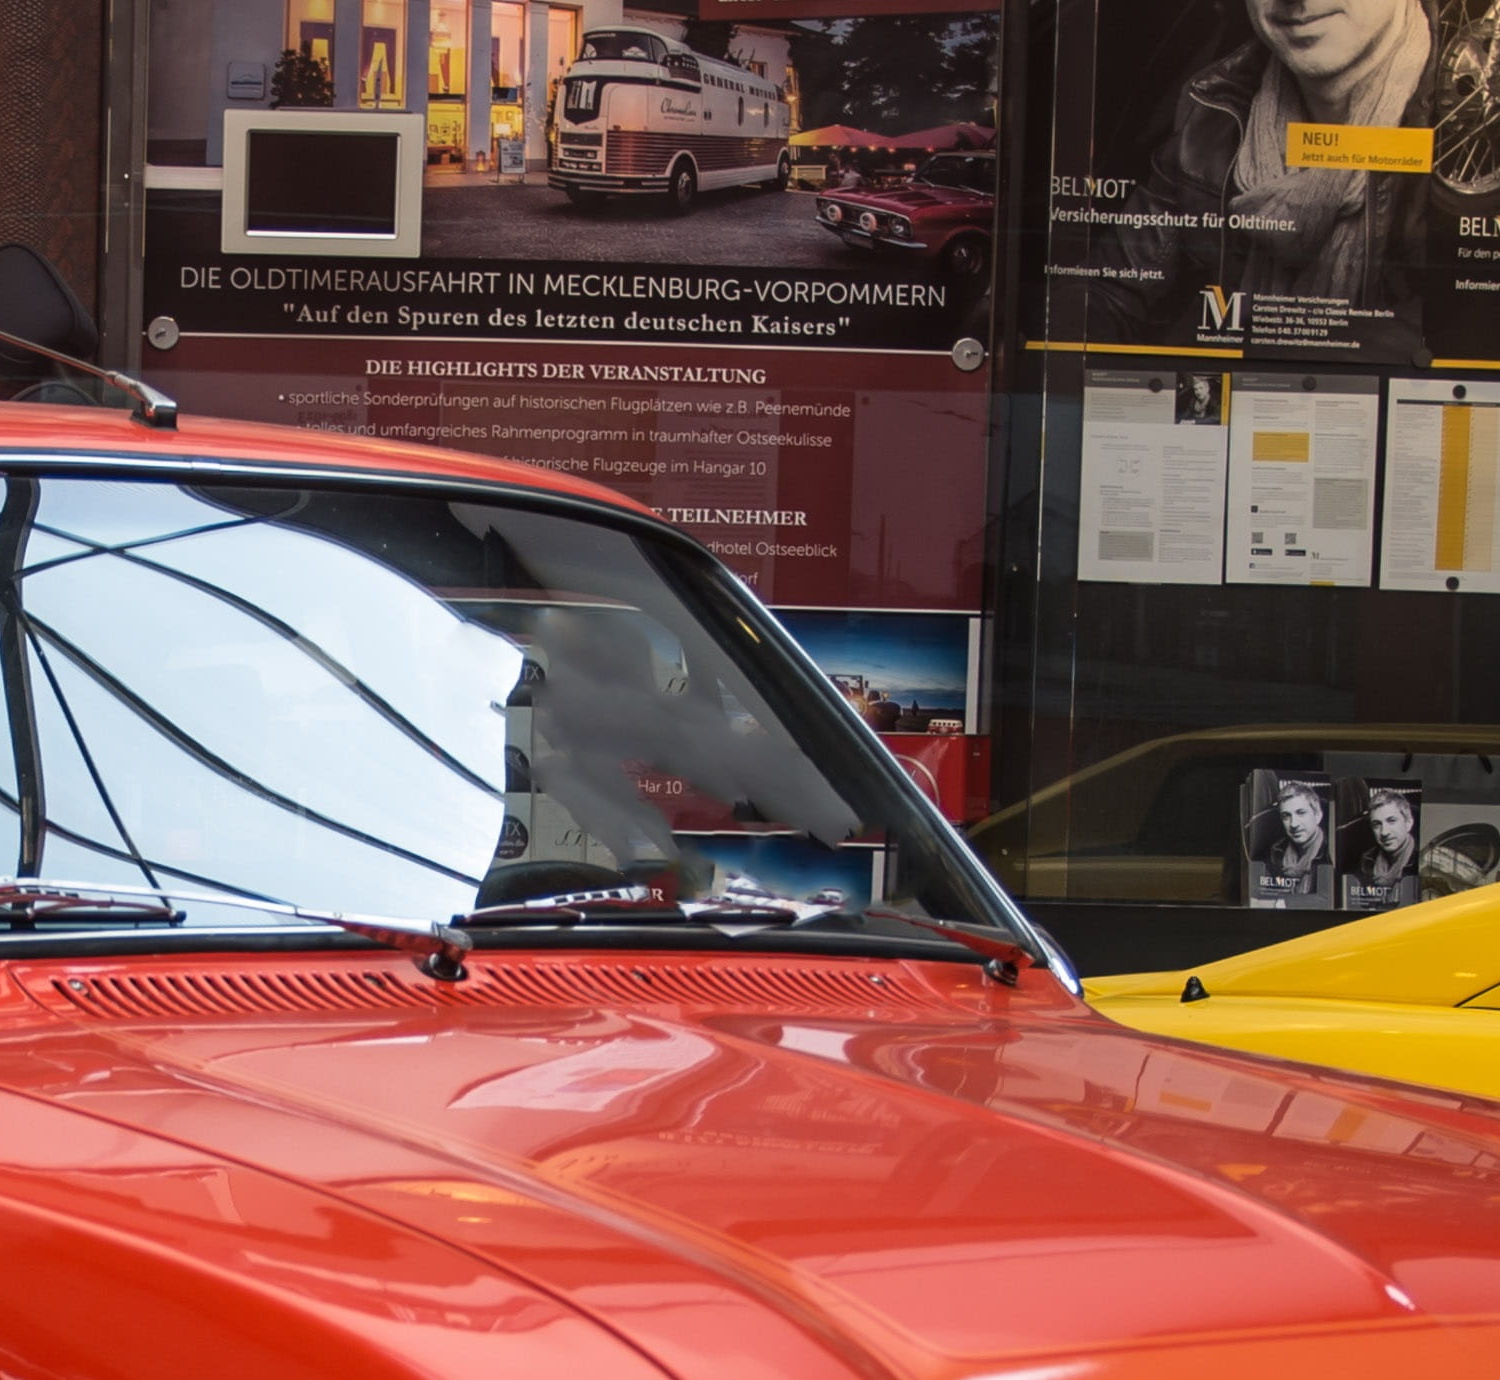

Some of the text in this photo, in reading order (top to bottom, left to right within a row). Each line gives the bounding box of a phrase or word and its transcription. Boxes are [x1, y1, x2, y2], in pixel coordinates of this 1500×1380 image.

[703, 72, 777, 101] GENERAL MOTORS
[1302, 131, 1339, 147] NEU!
[1301, 152, 1424, 167] Jetzt auch für Motorräder
[1049, 206, 1297, 232] Versicherungsschutz für Oldtimer.
[1457, 248, 1473, 259] Für
[1474, 248, 1491, 260] den
[1102, 266, 1165, 281] Sie sich jetzt.
[180, 266, 947, 308] DIE OLDTIMERAUSFAHRT IN MECKLENBURG-VORPOMMERN
[347, 304, 390, 326] den
[397, 306, 480, 331] Spuren
[487, 305, 528, 328] des
[534, 307, 616, 331] letzten
[623, 310, 743, 335] deutschen
[1196, 333, 1244, 344] Mannheimer
[364, 359, 767, 385] DIE HIGHLIGHTS DER VERANSTALTUNG
[288, 390, 852, 418] sportliche Sonderprüfungen auf historischen Flugplätzen wie z.B. Peenemünde
[348, 423, 376, 437] und
[380, 424, 488, 441] umfangreiches
[492, 424, 629, 443] Rahmenprogramm
[631, 427, 646, 442] in
[649, 429, 733, 446] traumhafter
[736, 430, 833, 448] Ostseekulisse
[592, 456, 668, 475] Flugzeuge
[670, 459, 690, 474] im
[693, 461, 746, 478] Hangar
[749, 461, 767, 476] 10
[667, 507, 808, 527] TEILNEHMER
[755, 541, 838, 558] Ostseeblick
[665, 781, 683, 794] 10
[1259, 875, 1297, 888] BELMOT
[1350, 885, 1389, 897] BELMOT
